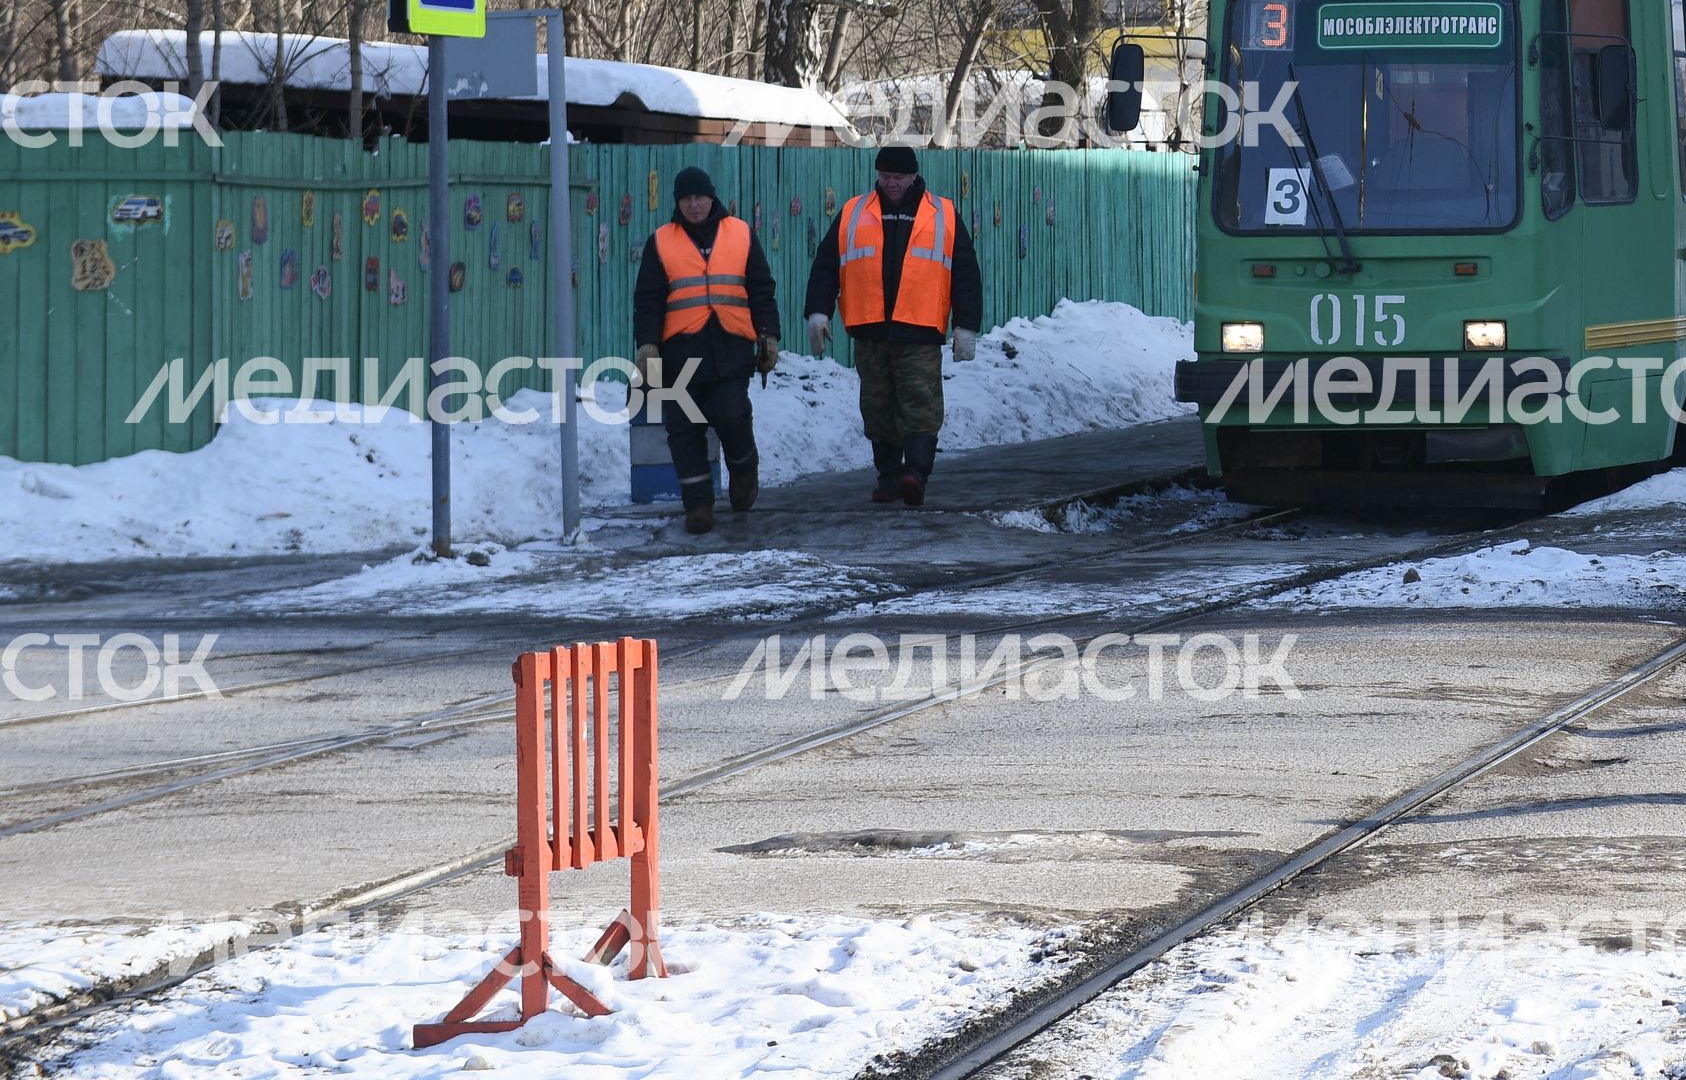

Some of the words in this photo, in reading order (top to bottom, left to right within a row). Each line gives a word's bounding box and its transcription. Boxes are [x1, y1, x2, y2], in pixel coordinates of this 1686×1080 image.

[1261, 2, 1288, 47] 3
[1323, 16, 1497, 37] МОСОБЛЭЛЕКТРОТРАНС
[1273, 178, 1301, 215] 3
[1310, 293, 1406, 346] 015
